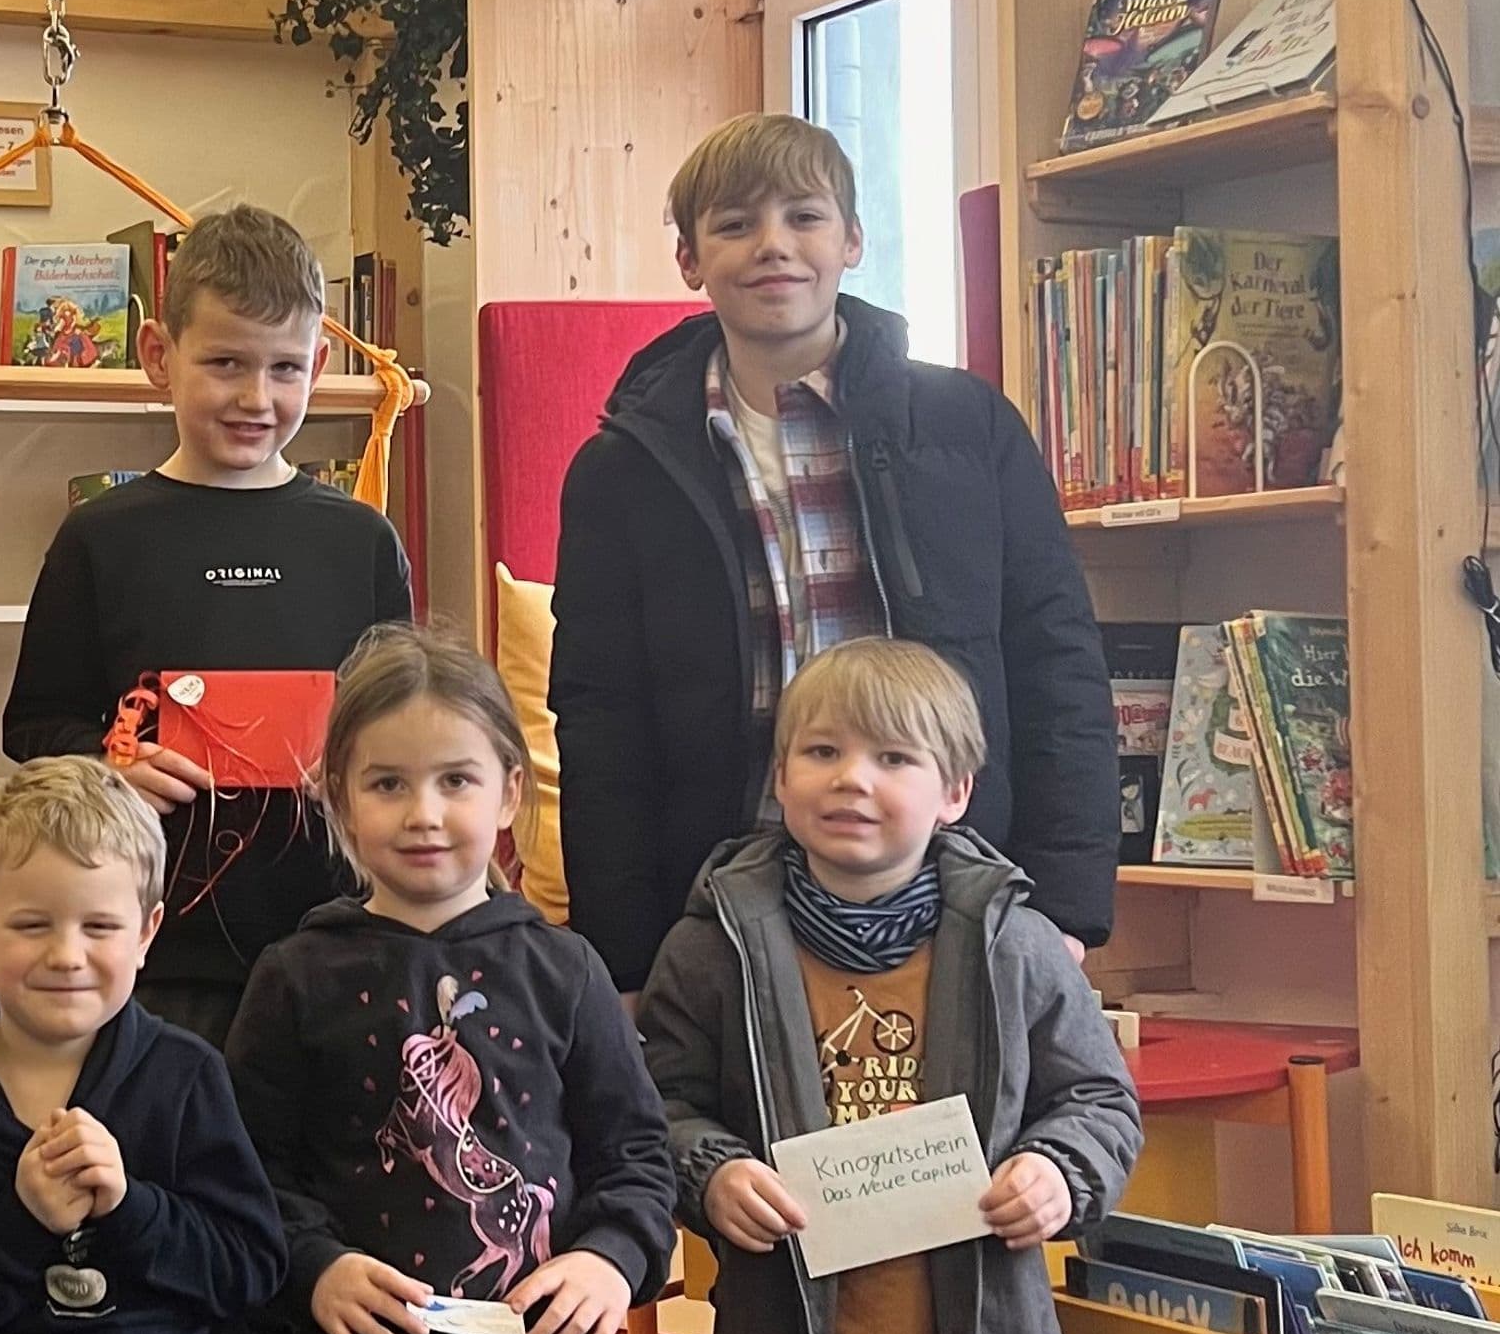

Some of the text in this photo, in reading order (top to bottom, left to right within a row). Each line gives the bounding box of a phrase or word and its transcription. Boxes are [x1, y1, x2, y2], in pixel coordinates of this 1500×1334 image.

[25, 256, 40, 265] Der
[1254, 251, 1283, 270] Der
[1230, 272, 1304, 295] Karneval
[1231, 295, 1304, 319] der Tiere
[205, 567, 282, 581] ORIGINAL
[1291, 667, 1329, 687] die
[862, 1055, 922, 1079] RID
[837, 1079, 917, 1103] YOUR
[812, 1136, 968, 1181] Kinogutschein
[822, 1187, 852, 1204] Das
[858, 1175, 906, 1197] Neue
[1397, 1234, 1476, 1268] Ich komm
